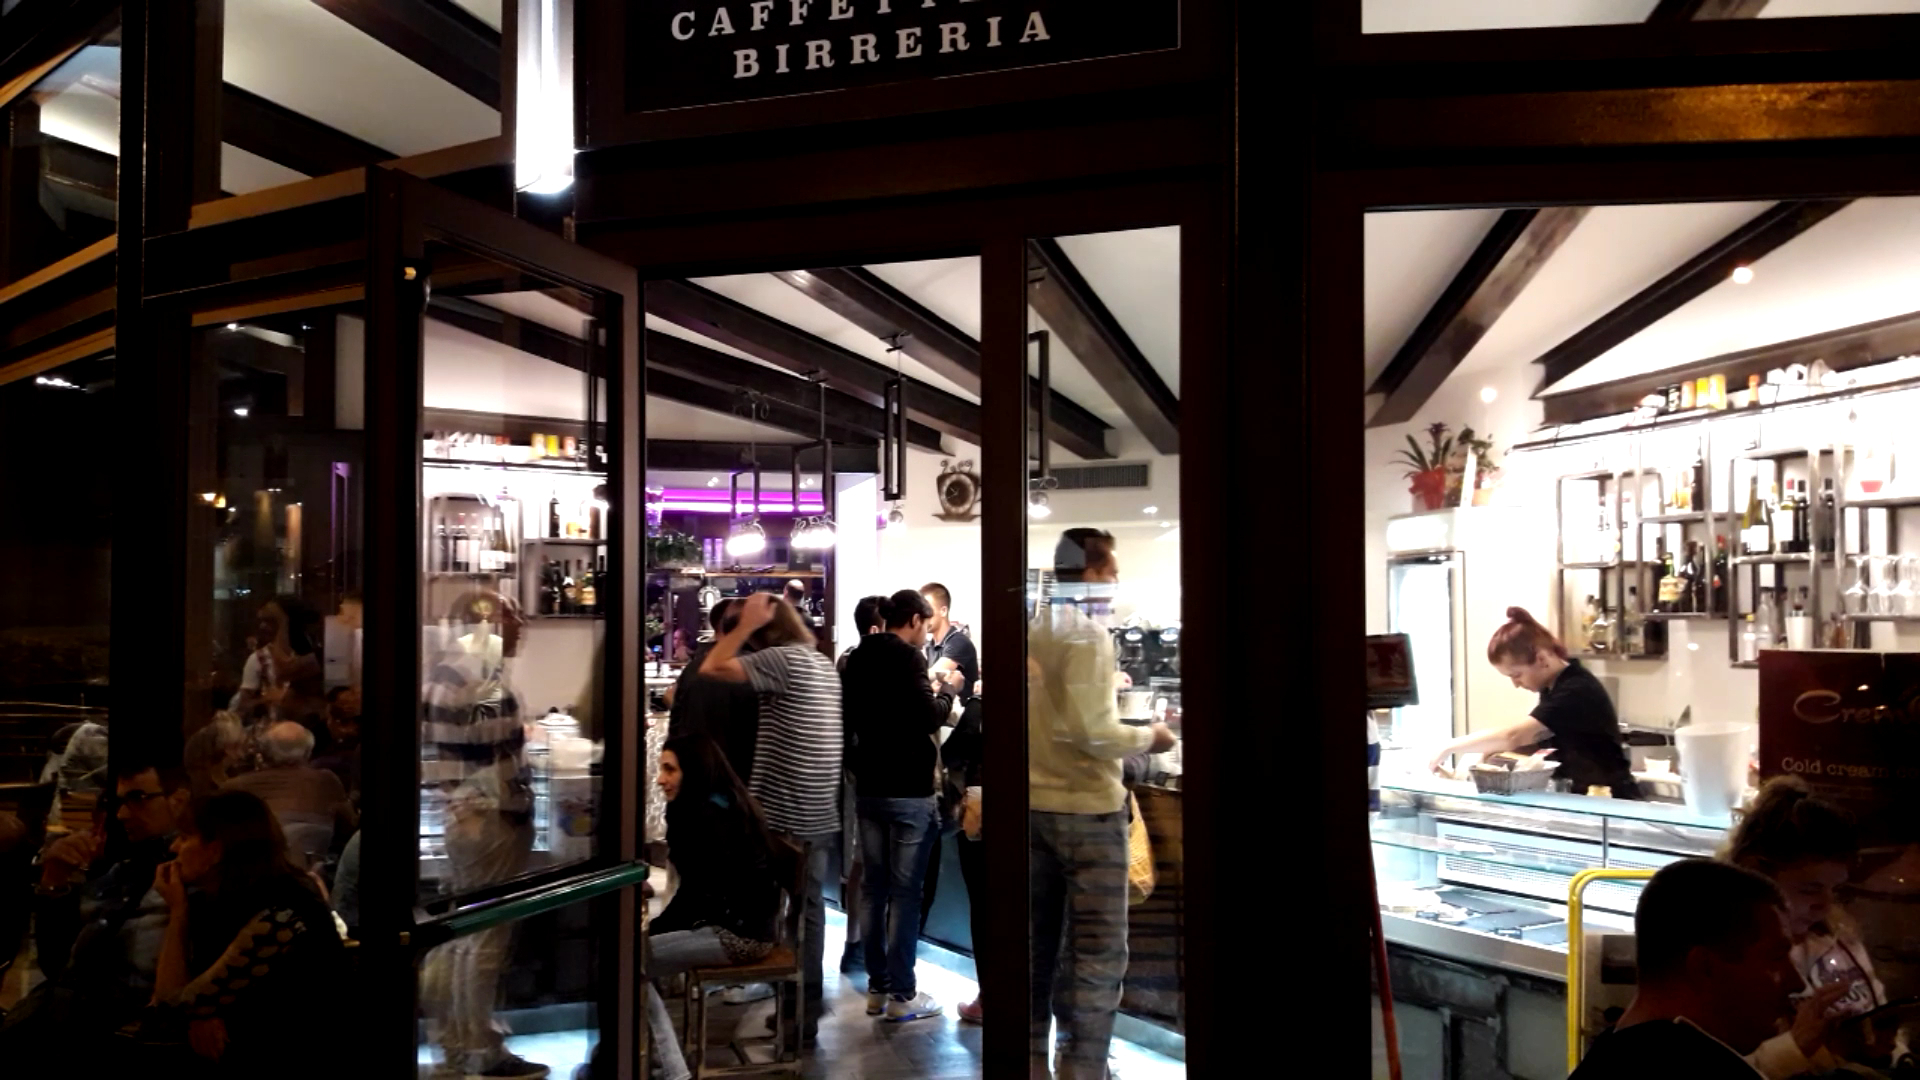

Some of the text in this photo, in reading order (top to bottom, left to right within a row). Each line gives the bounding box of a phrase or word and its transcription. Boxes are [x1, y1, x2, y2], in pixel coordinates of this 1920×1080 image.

[671, 0, 972, 41] CAFFE
[733, 11, 1051, 79] BIRRERIA
[1781, 756, 1823, 775] Cold
[1826, 763, 1890, 779] cream
